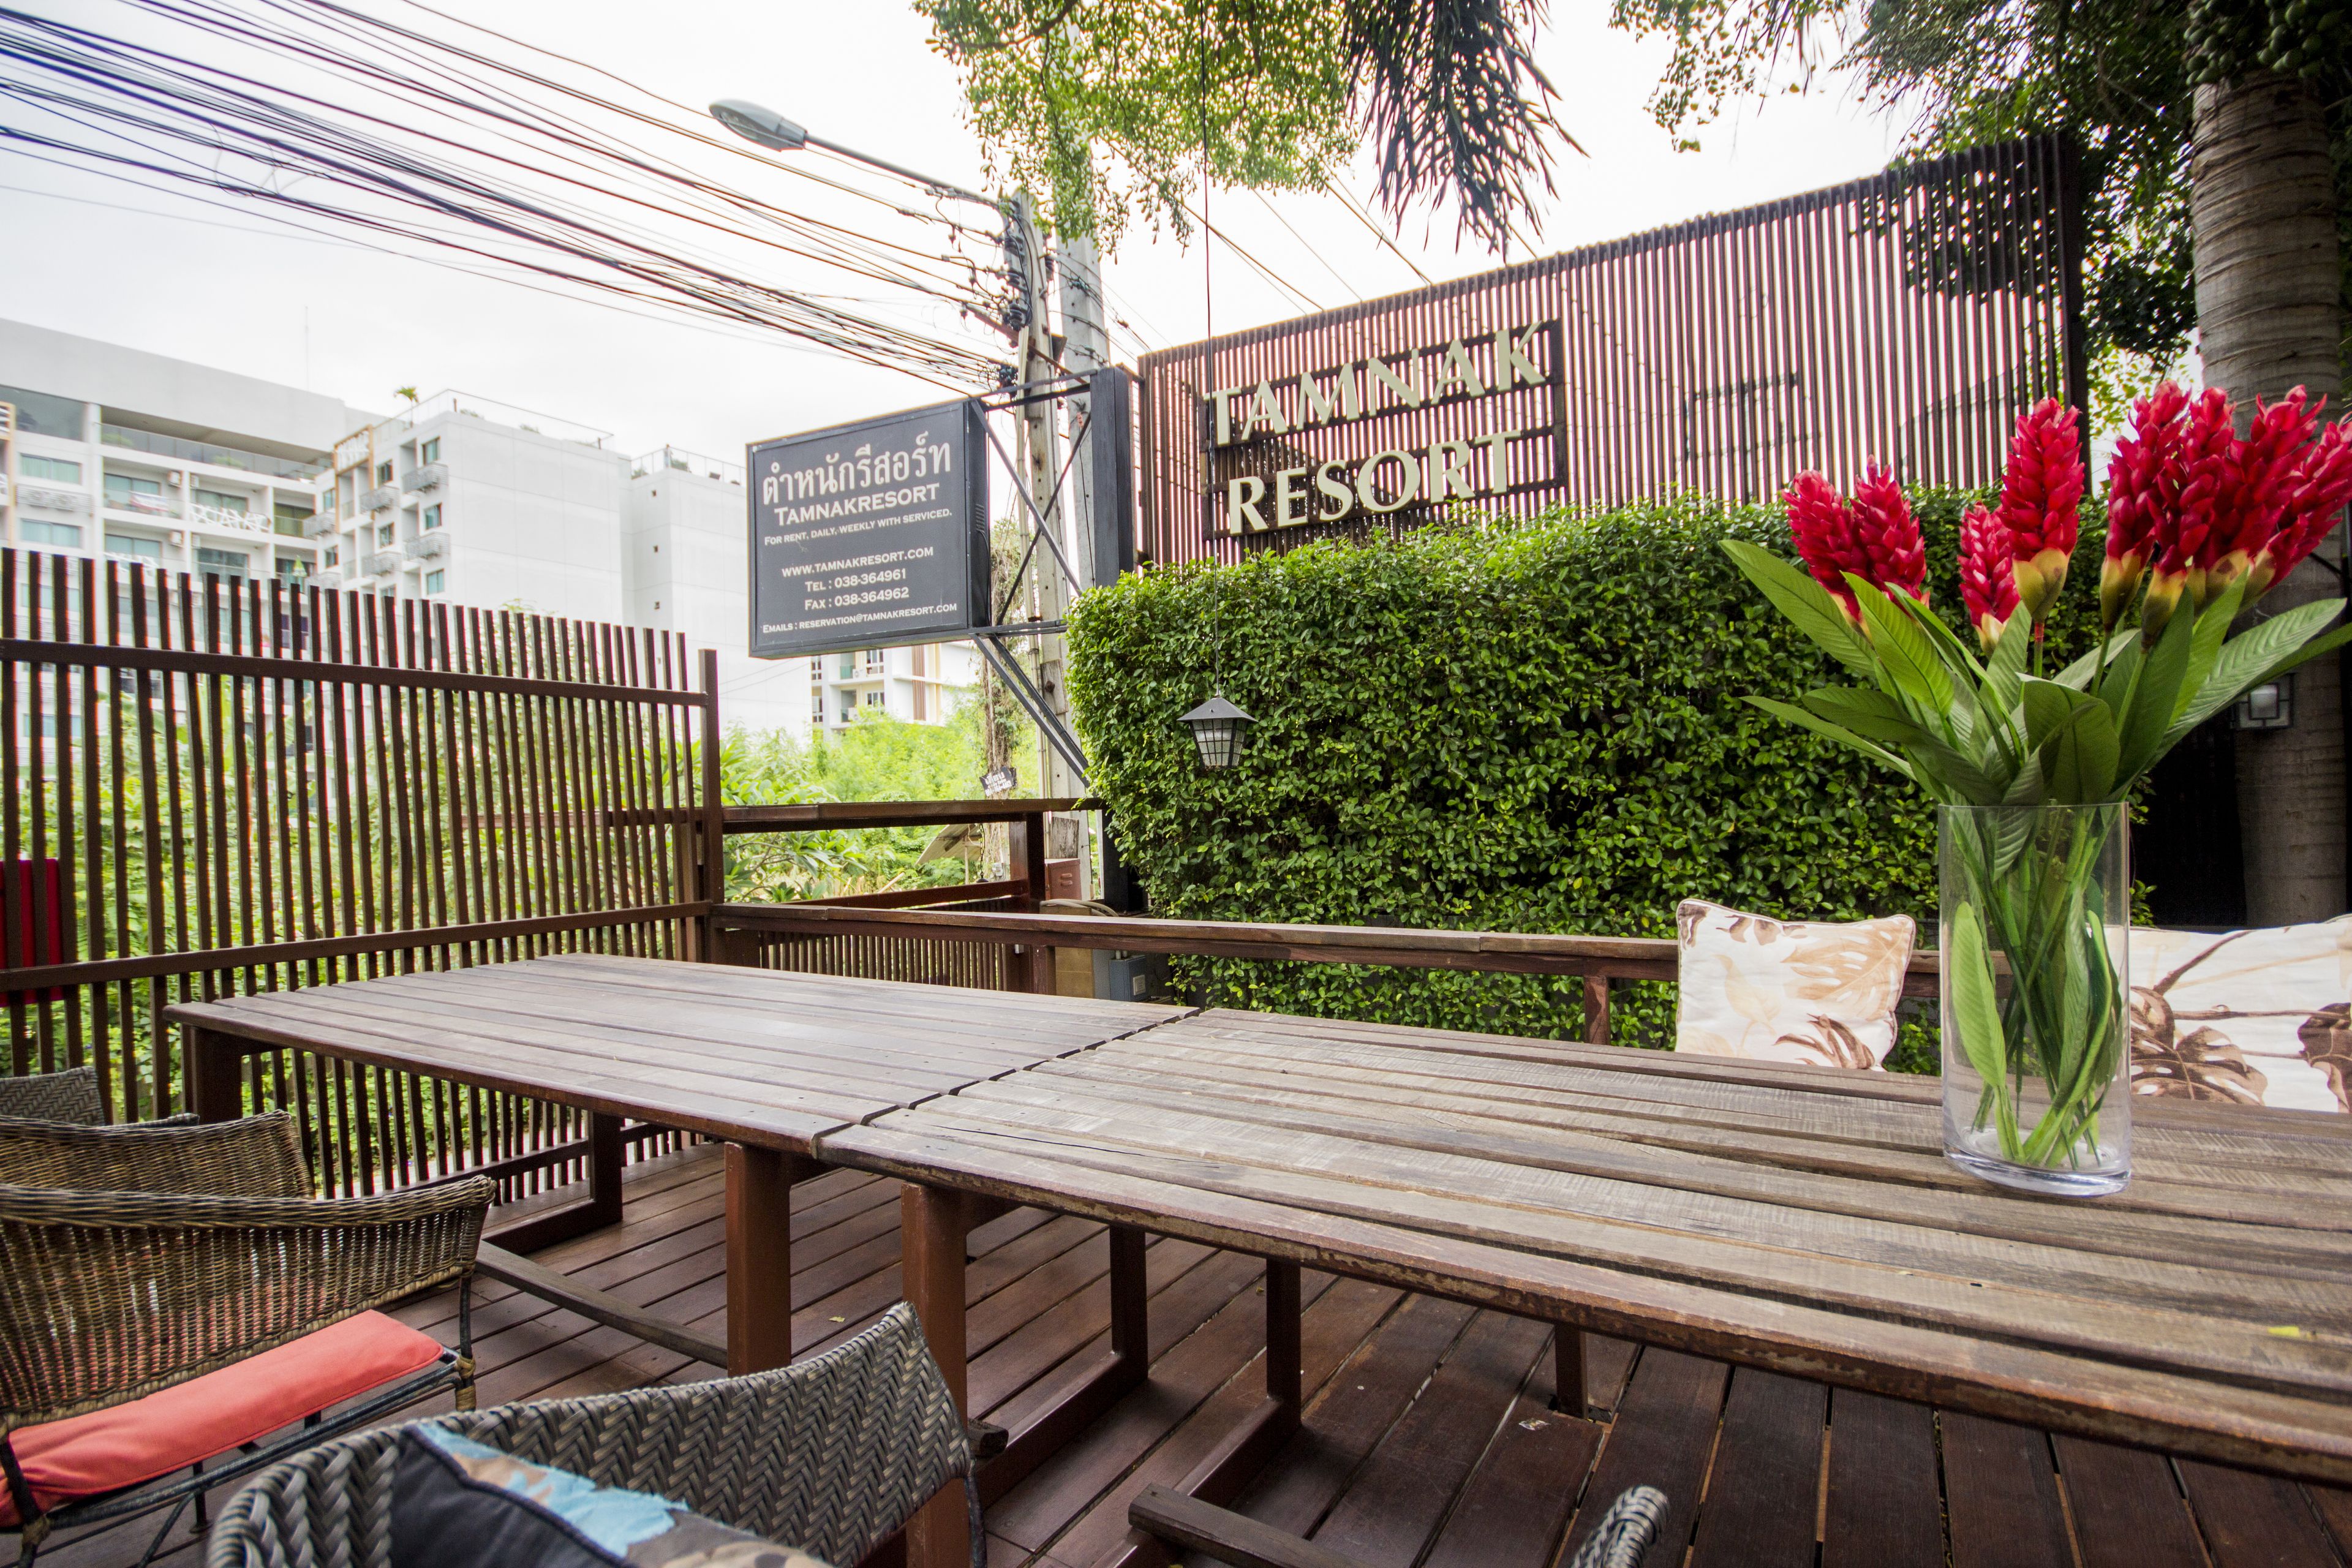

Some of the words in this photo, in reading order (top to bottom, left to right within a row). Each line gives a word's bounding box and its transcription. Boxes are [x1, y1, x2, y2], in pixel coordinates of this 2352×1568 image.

[1204, 320, 1547, 447] TAMNAK
[763, 431, 951, 505] ตำหนักรีสอร์ท
[1229, 430, 1521, 535] RESORT
[774, 483, 940, 526] TAMNAKRESORT
[764, 536, 782, 545] FOR
[839, 521, 875, 533] WEEKLY
[878, 516, 901, 527] WITH
[903, 508, 952, 523] SERVICED.
[782, 546, 933, 577] WWW.TAMNAKRESORT.COM
[834, 568, 906, 588] 038-364961
[834, 587, 910, 606] 038-364962
[799, 603, 957, 629] RESERVATION@TAMNAKRESORT.COM
